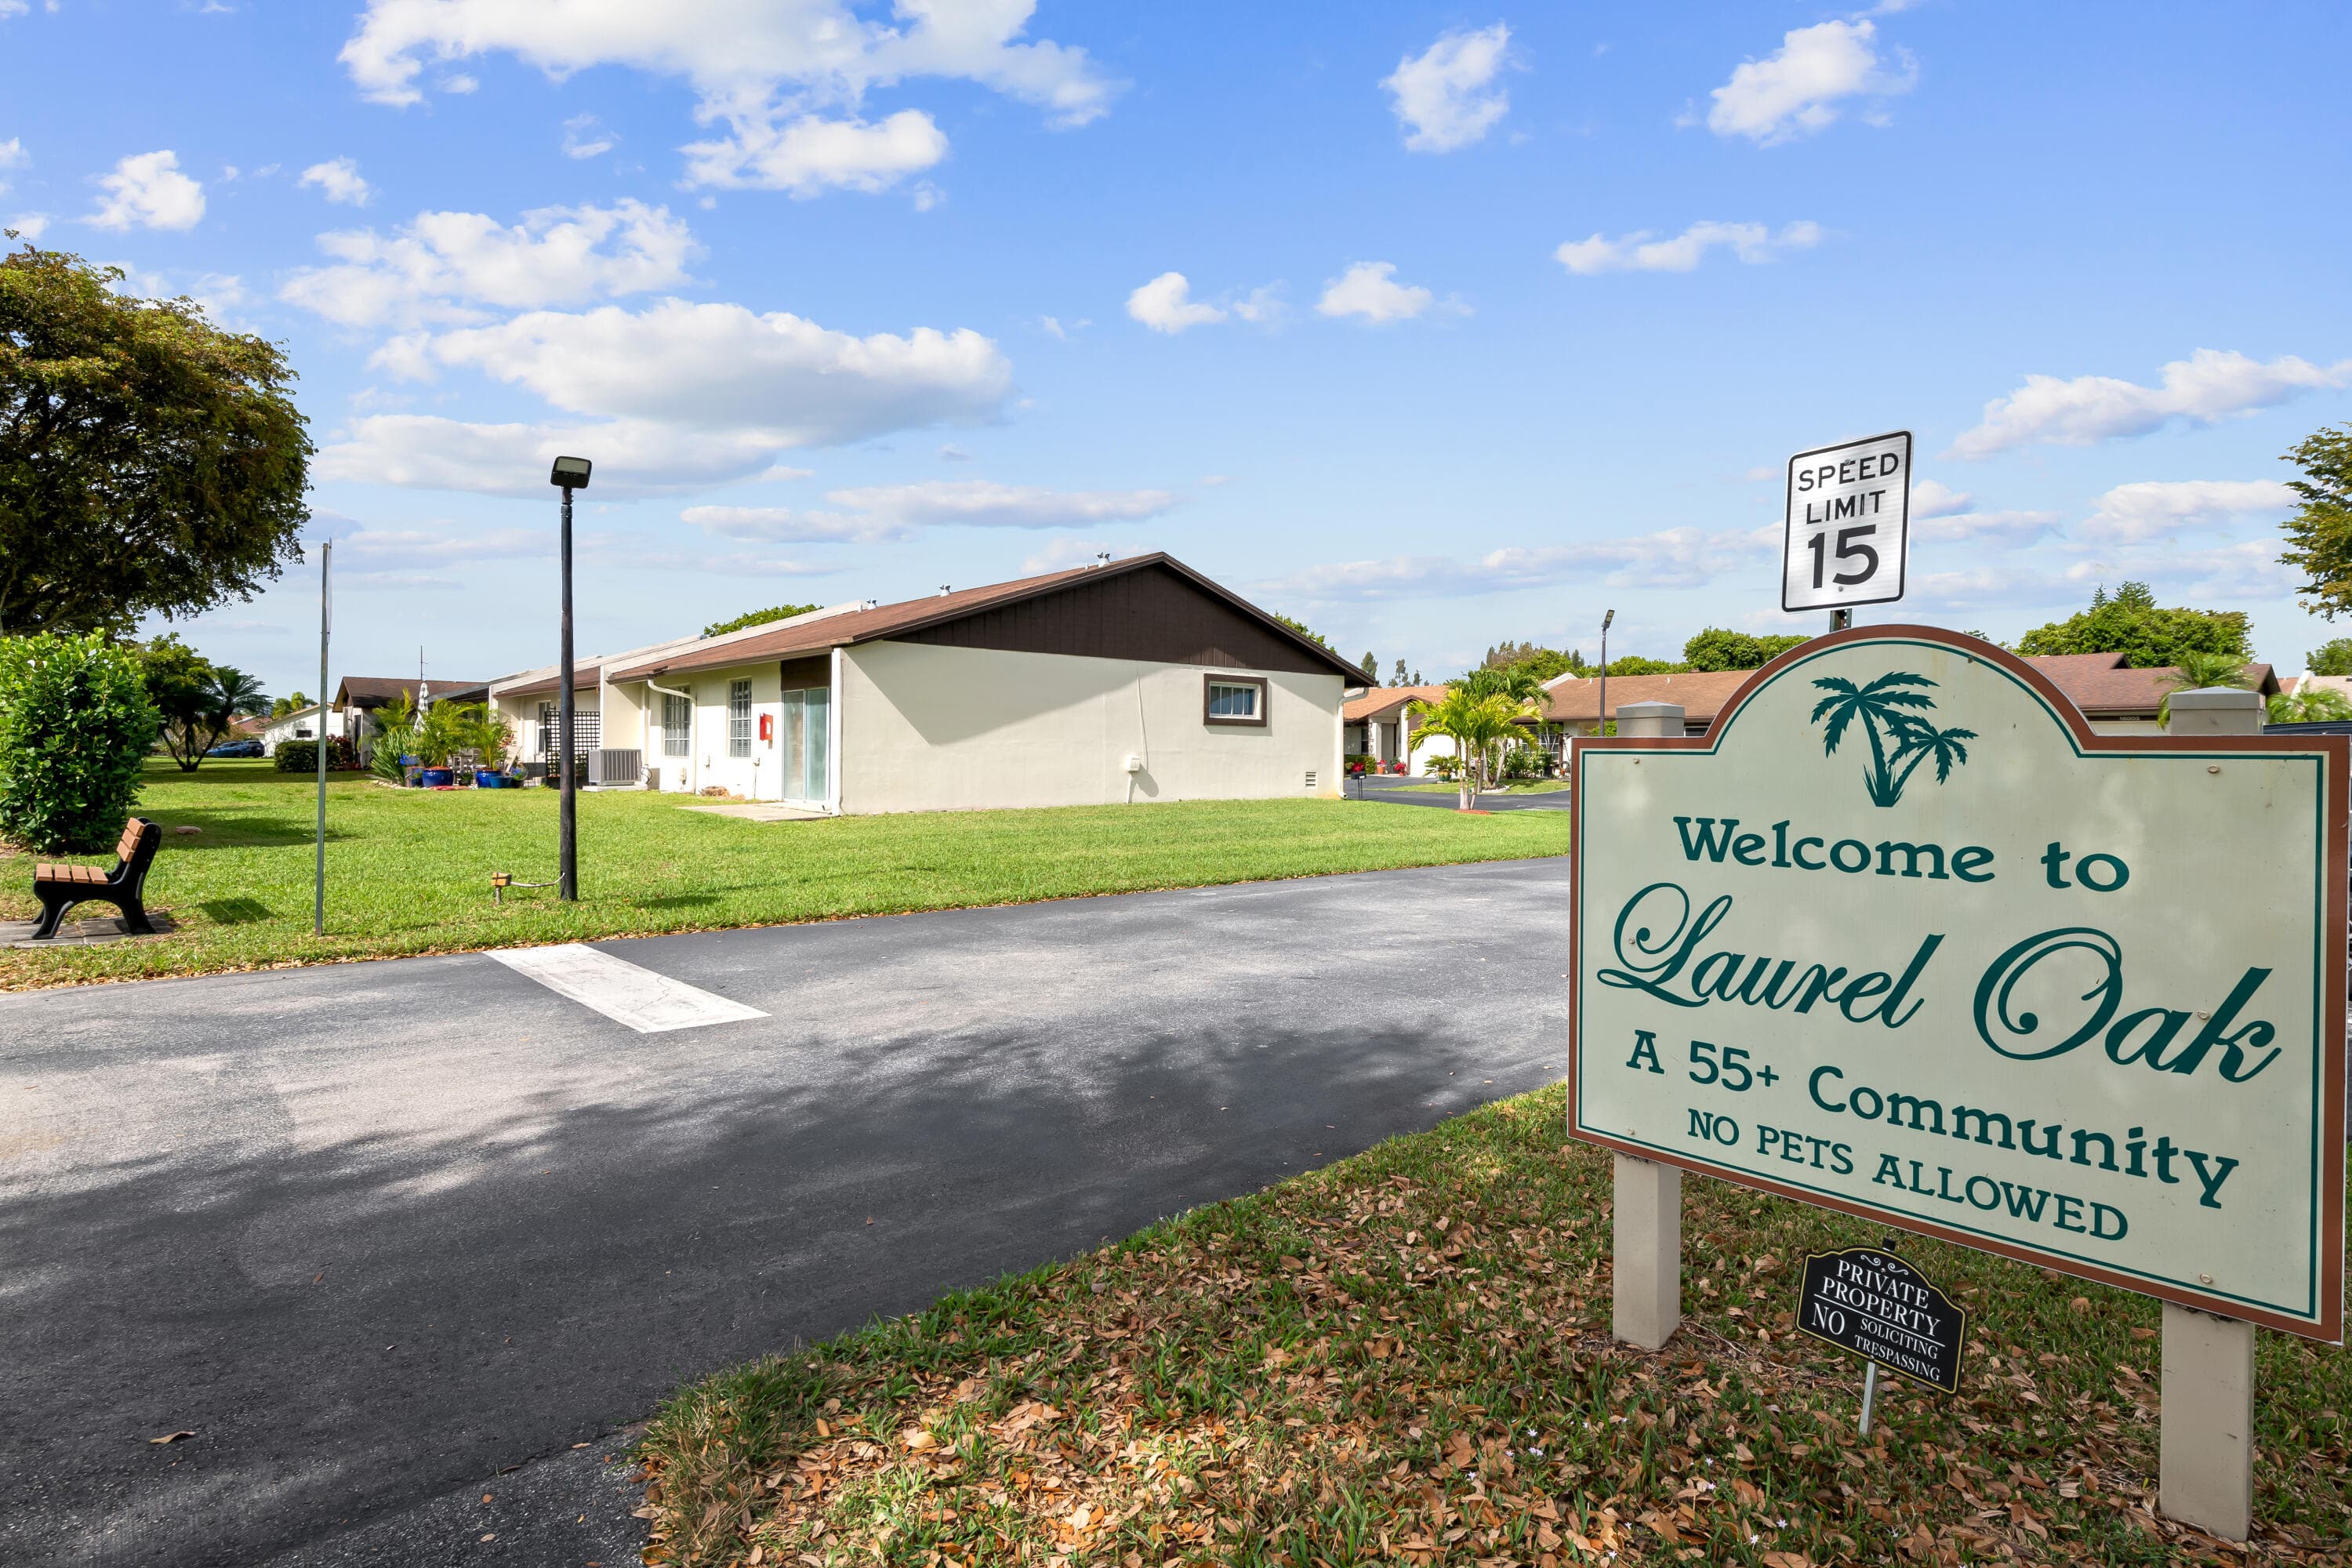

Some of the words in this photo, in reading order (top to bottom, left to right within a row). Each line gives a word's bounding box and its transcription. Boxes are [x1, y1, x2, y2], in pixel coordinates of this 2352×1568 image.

[1798, 452, 1899, 492] SPEED
[1806, 490, 1886, 524] LIMIT
[1808, 524, 1879, 590] 15
[1674, 816, 1995, 883] Welcome
[2041, 842, 2130, 892] to
[1597, 882, 1946, 1029] Laurel
[1973, 927, 2282, 1083] Oak
[1626, 1029, 1664, 1075] A
[1687, 1040, 1780, 1092] 55+
[1809, 1065, 2240, 1209] Community
[1687, 1108, 1739, 1145] NO
[1756, 1126, 1853, 1175] PETS
[1872, 1153, 2129, 1241] ALLOWED
[1821, 1276, 1941, 1337] PROPERTY
[1836, 1259, 1929, 1309] PRIVATE
[1811, 1302, 1846, 1335] NO
[1860, 1318, 1938, 1359] SOLICITING
[1854, 1334, 1940, 1381] TRESPASSING
